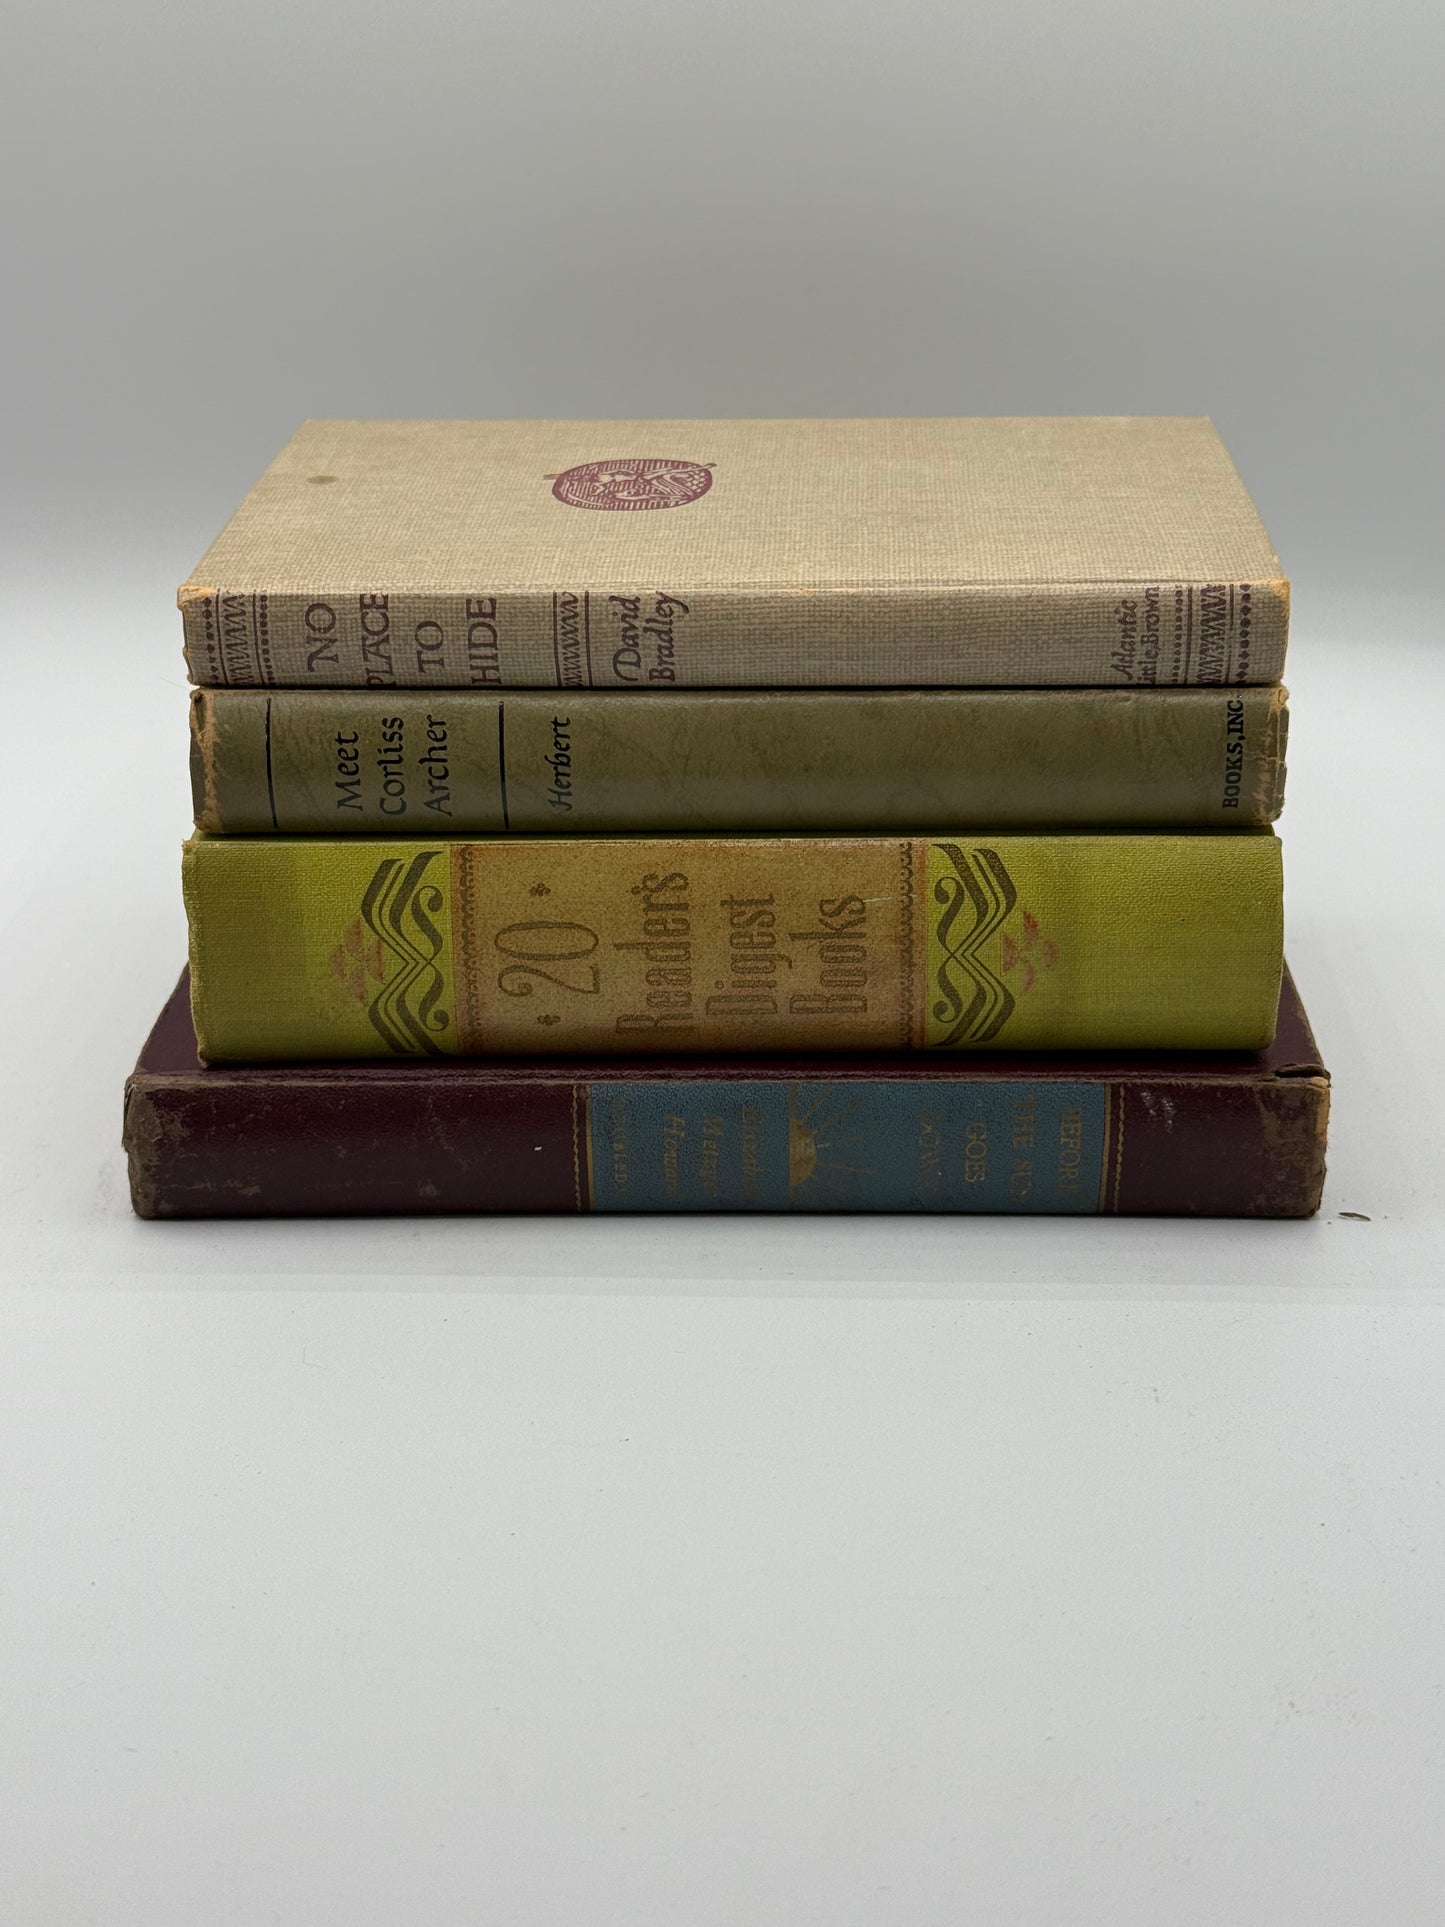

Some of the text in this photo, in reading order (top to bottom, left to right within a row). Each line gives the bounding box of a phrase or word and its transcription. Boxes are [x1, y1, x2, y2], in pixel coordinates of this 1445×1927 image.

[304, 603, 341, 673] NO
[358, 592, 397, 687] PLACE
[415, 619, 446, 675] TO
[467, 597, 502, 686] HIDE
[612, 595, 643, 681] David
[648, 591, 690, 684] Bradley
[1110, 599, 1138, 681] Atlantic
[336, 730, 363, 812] Meet
[377, 716, 407, 817] Corliss
[418, 714, 453, 818] Archer
[544, 716, 573, 812] Herbert
[494, 920, 599, 998] 20
[613, 871, 695, 1035] Reader's
[706, 893, 794, 1016] Digest
[788, 893, 868, 1015] Books
[964, 1121, 987, 1183] GOES
